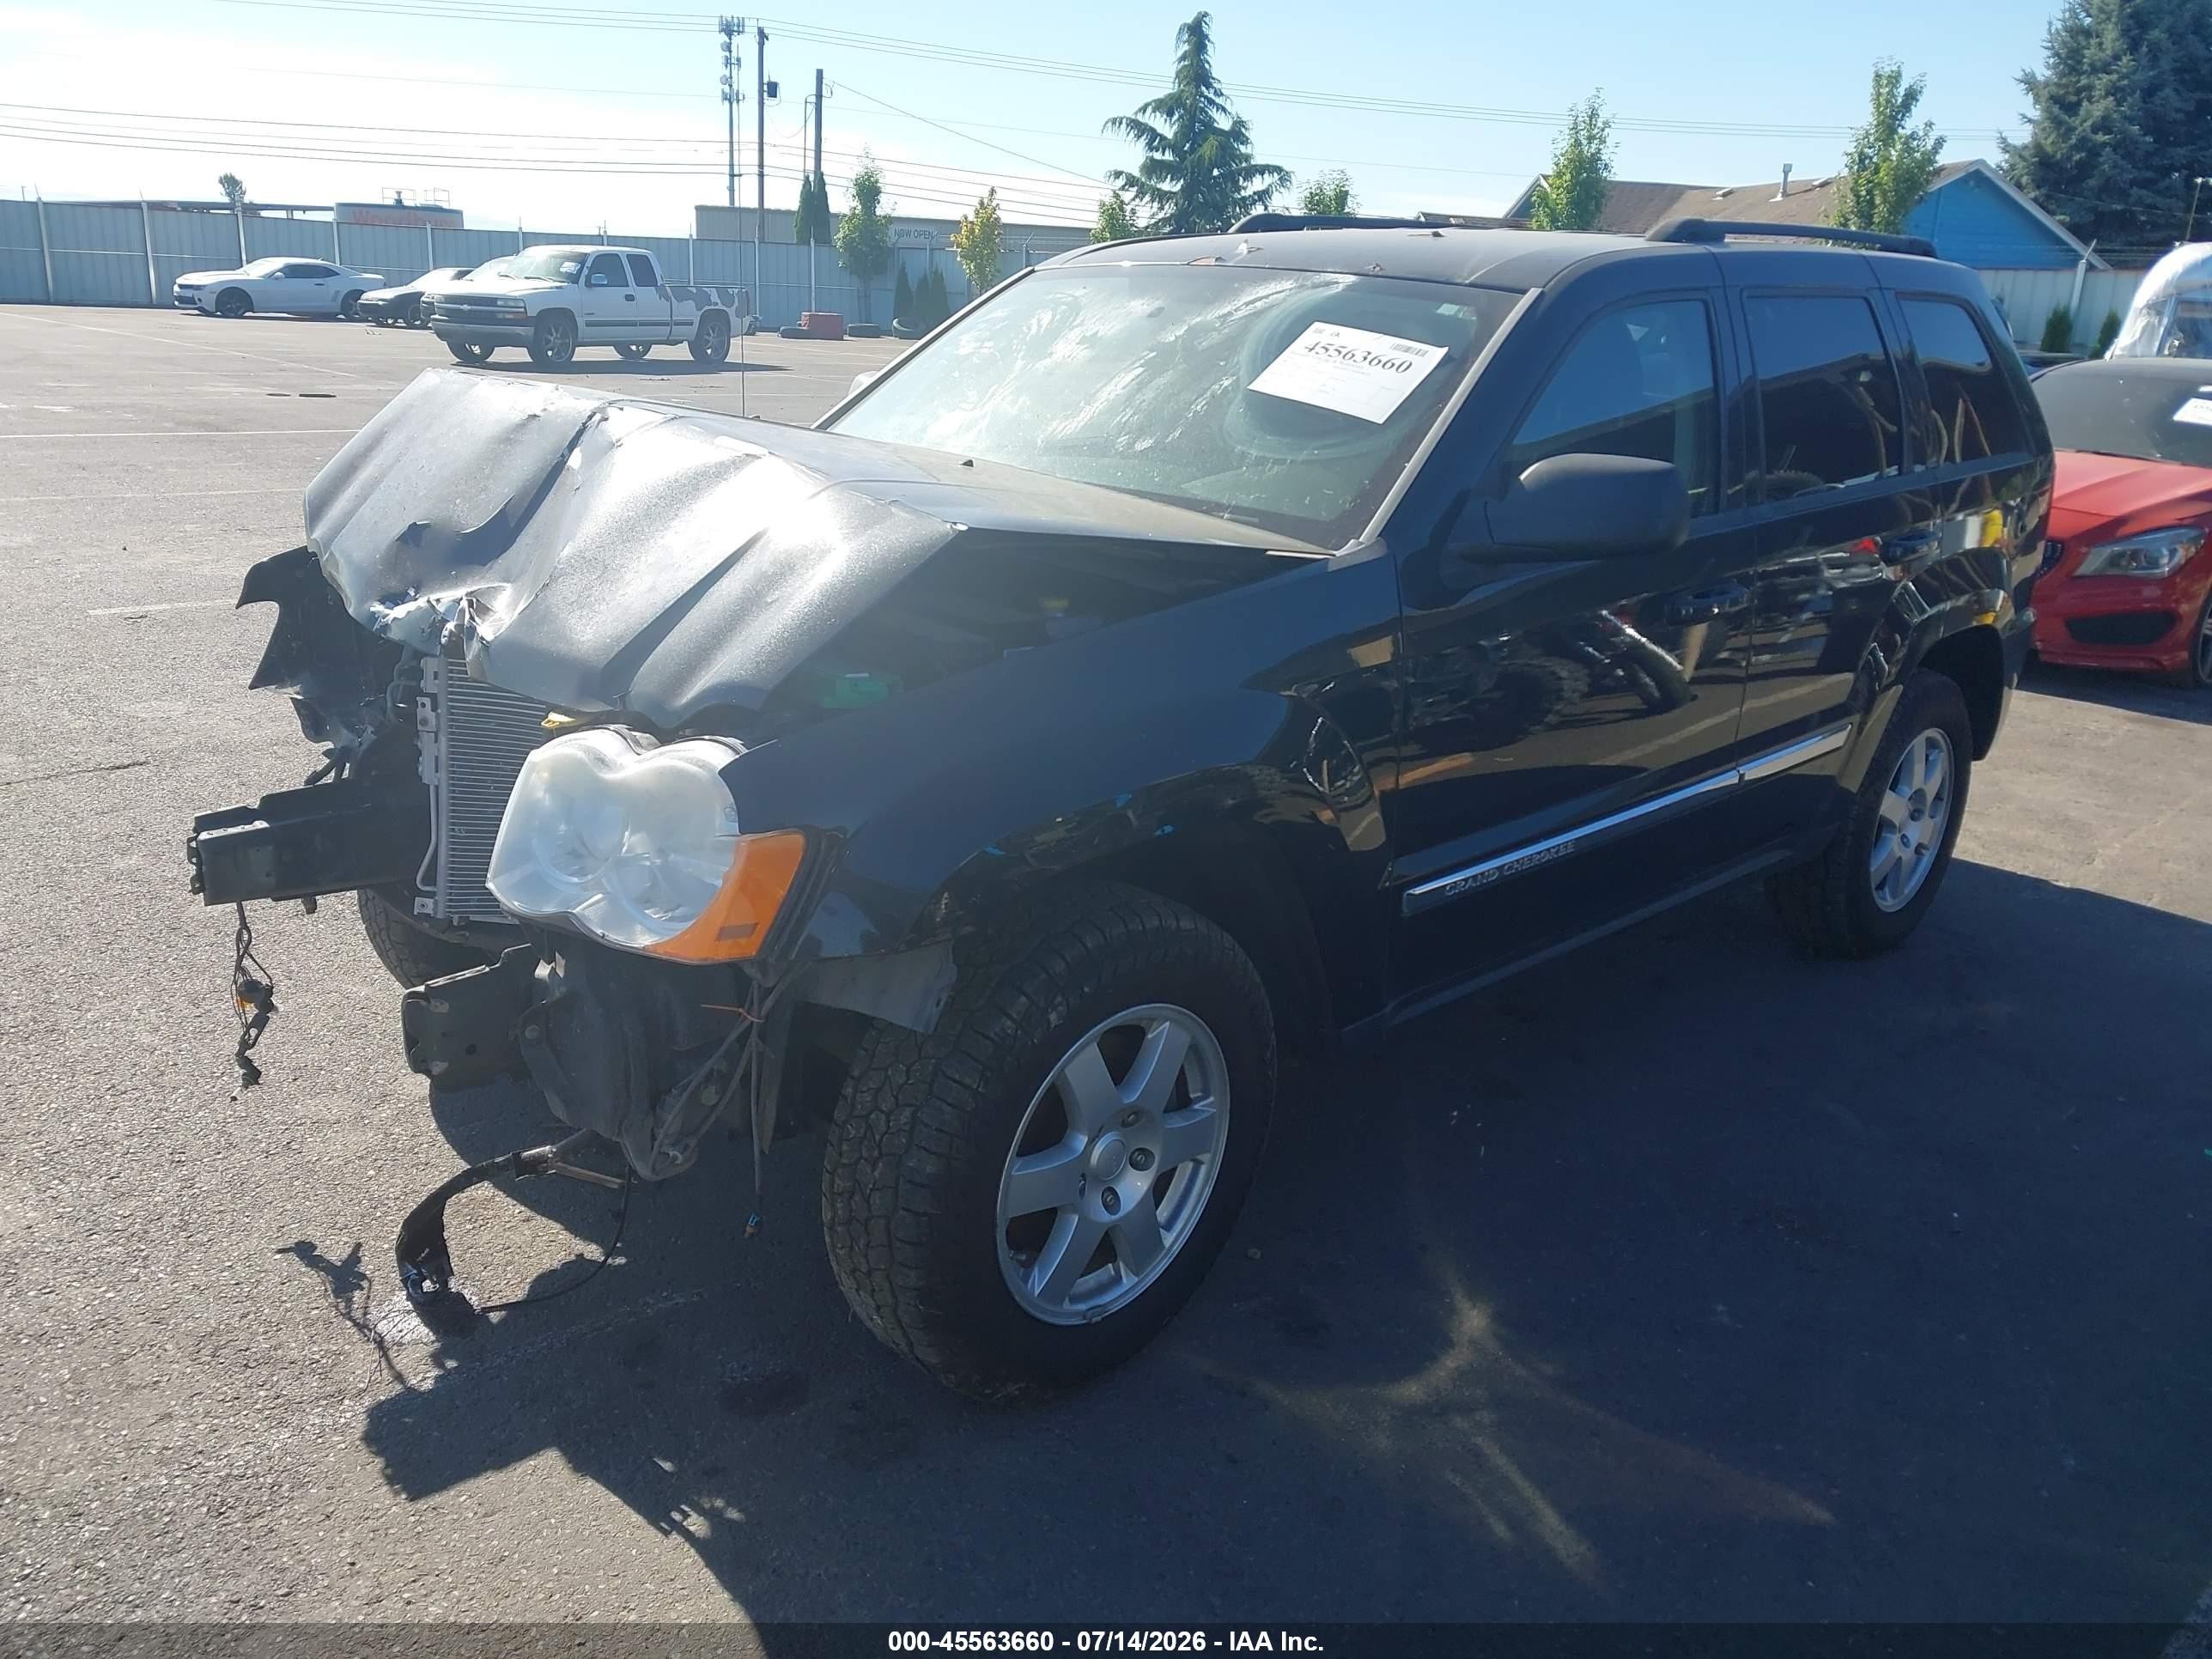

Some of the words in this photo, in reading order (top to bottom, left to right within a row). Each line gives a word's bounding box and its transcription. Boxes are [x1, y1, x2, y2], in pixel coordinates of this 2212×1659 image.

[894, 228, 912, 238] NOW
[914, 229, 933, 240] OPEN
[1304, 341, 1413, 374] 45563660
[1444, 869, 1498, 896] GRAND
[1503, 841, 1576, 876] CHEROKEE
